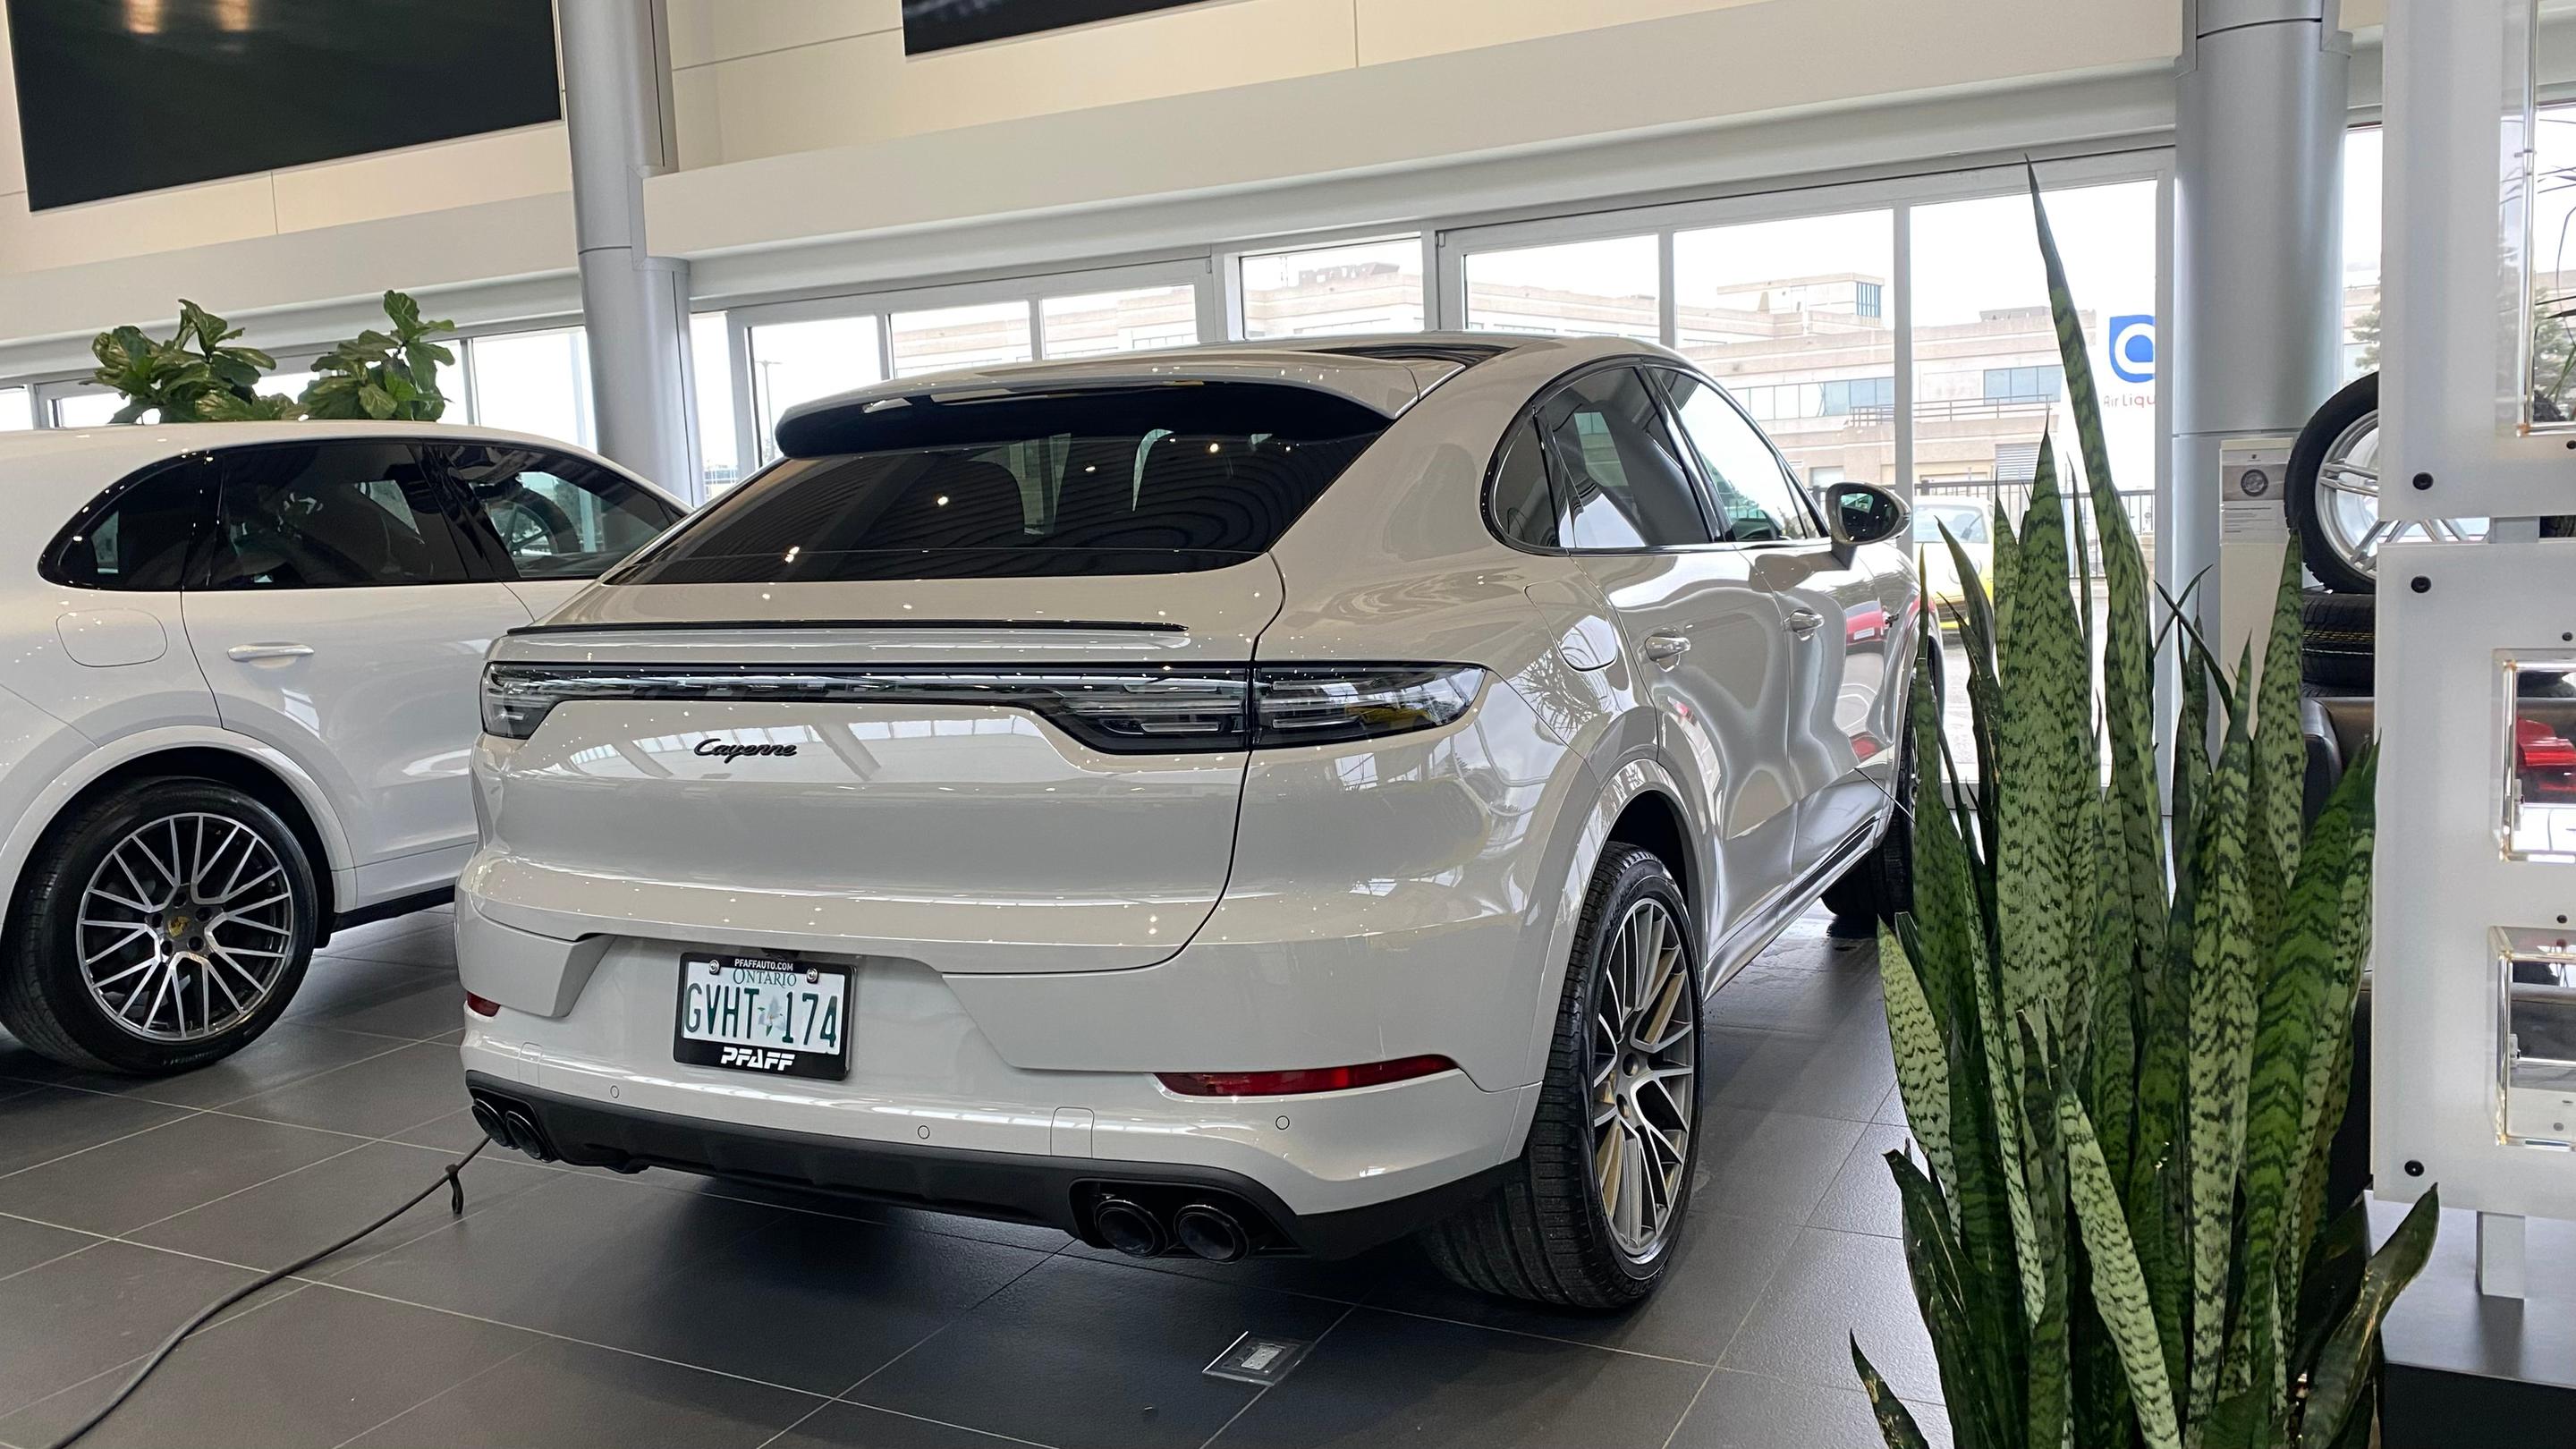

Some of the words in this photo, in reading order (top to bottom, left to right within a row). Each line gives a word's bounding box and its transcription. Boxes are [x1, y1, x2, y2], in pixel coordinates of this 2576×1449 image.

[2103, 394, 2119, 408] Air
[694, 738, 798, 764] Cayenne
[734, 958, 794, 971] PFAFFAUTO.COM
[733, 968, 797, 987] ONTARIO
[685, 982, 759, 1039] GVHT
[782, 991, 838, 1048] 174
[721, 1046, 795, 1072] PFAFF
